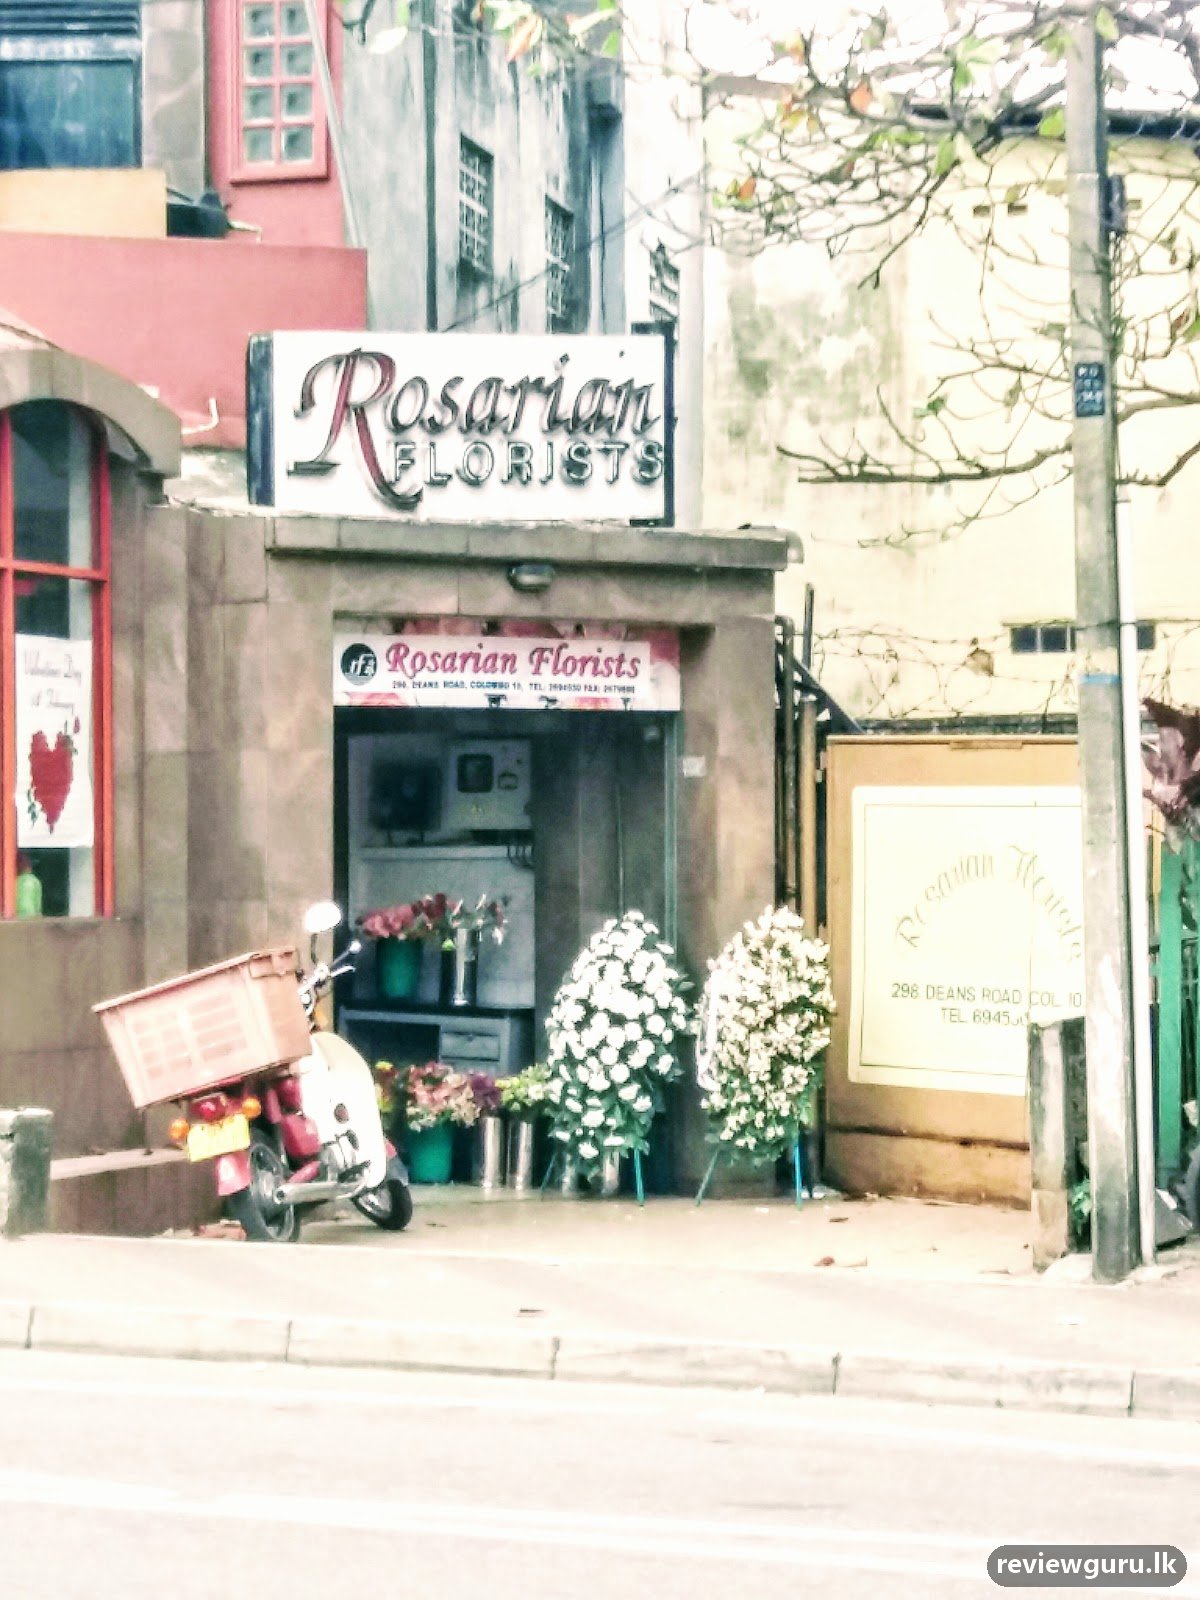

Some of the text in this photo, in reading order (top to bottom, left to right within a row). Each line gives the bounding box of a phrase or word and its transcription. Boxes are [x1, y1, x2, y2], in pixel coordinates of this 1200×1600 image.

[288, 348, 660, 510] Rosarian
[390, 440, 664, 486] FLORISTS
[386, 642, 641, 679] Rosarian Florists
[891, 982, 920, 1000] 298
[926, 985, 976, 1002] DEANS
[981, 987, 1023, 1006] ROAD
[1029, 991, 1061, 1008] COL
